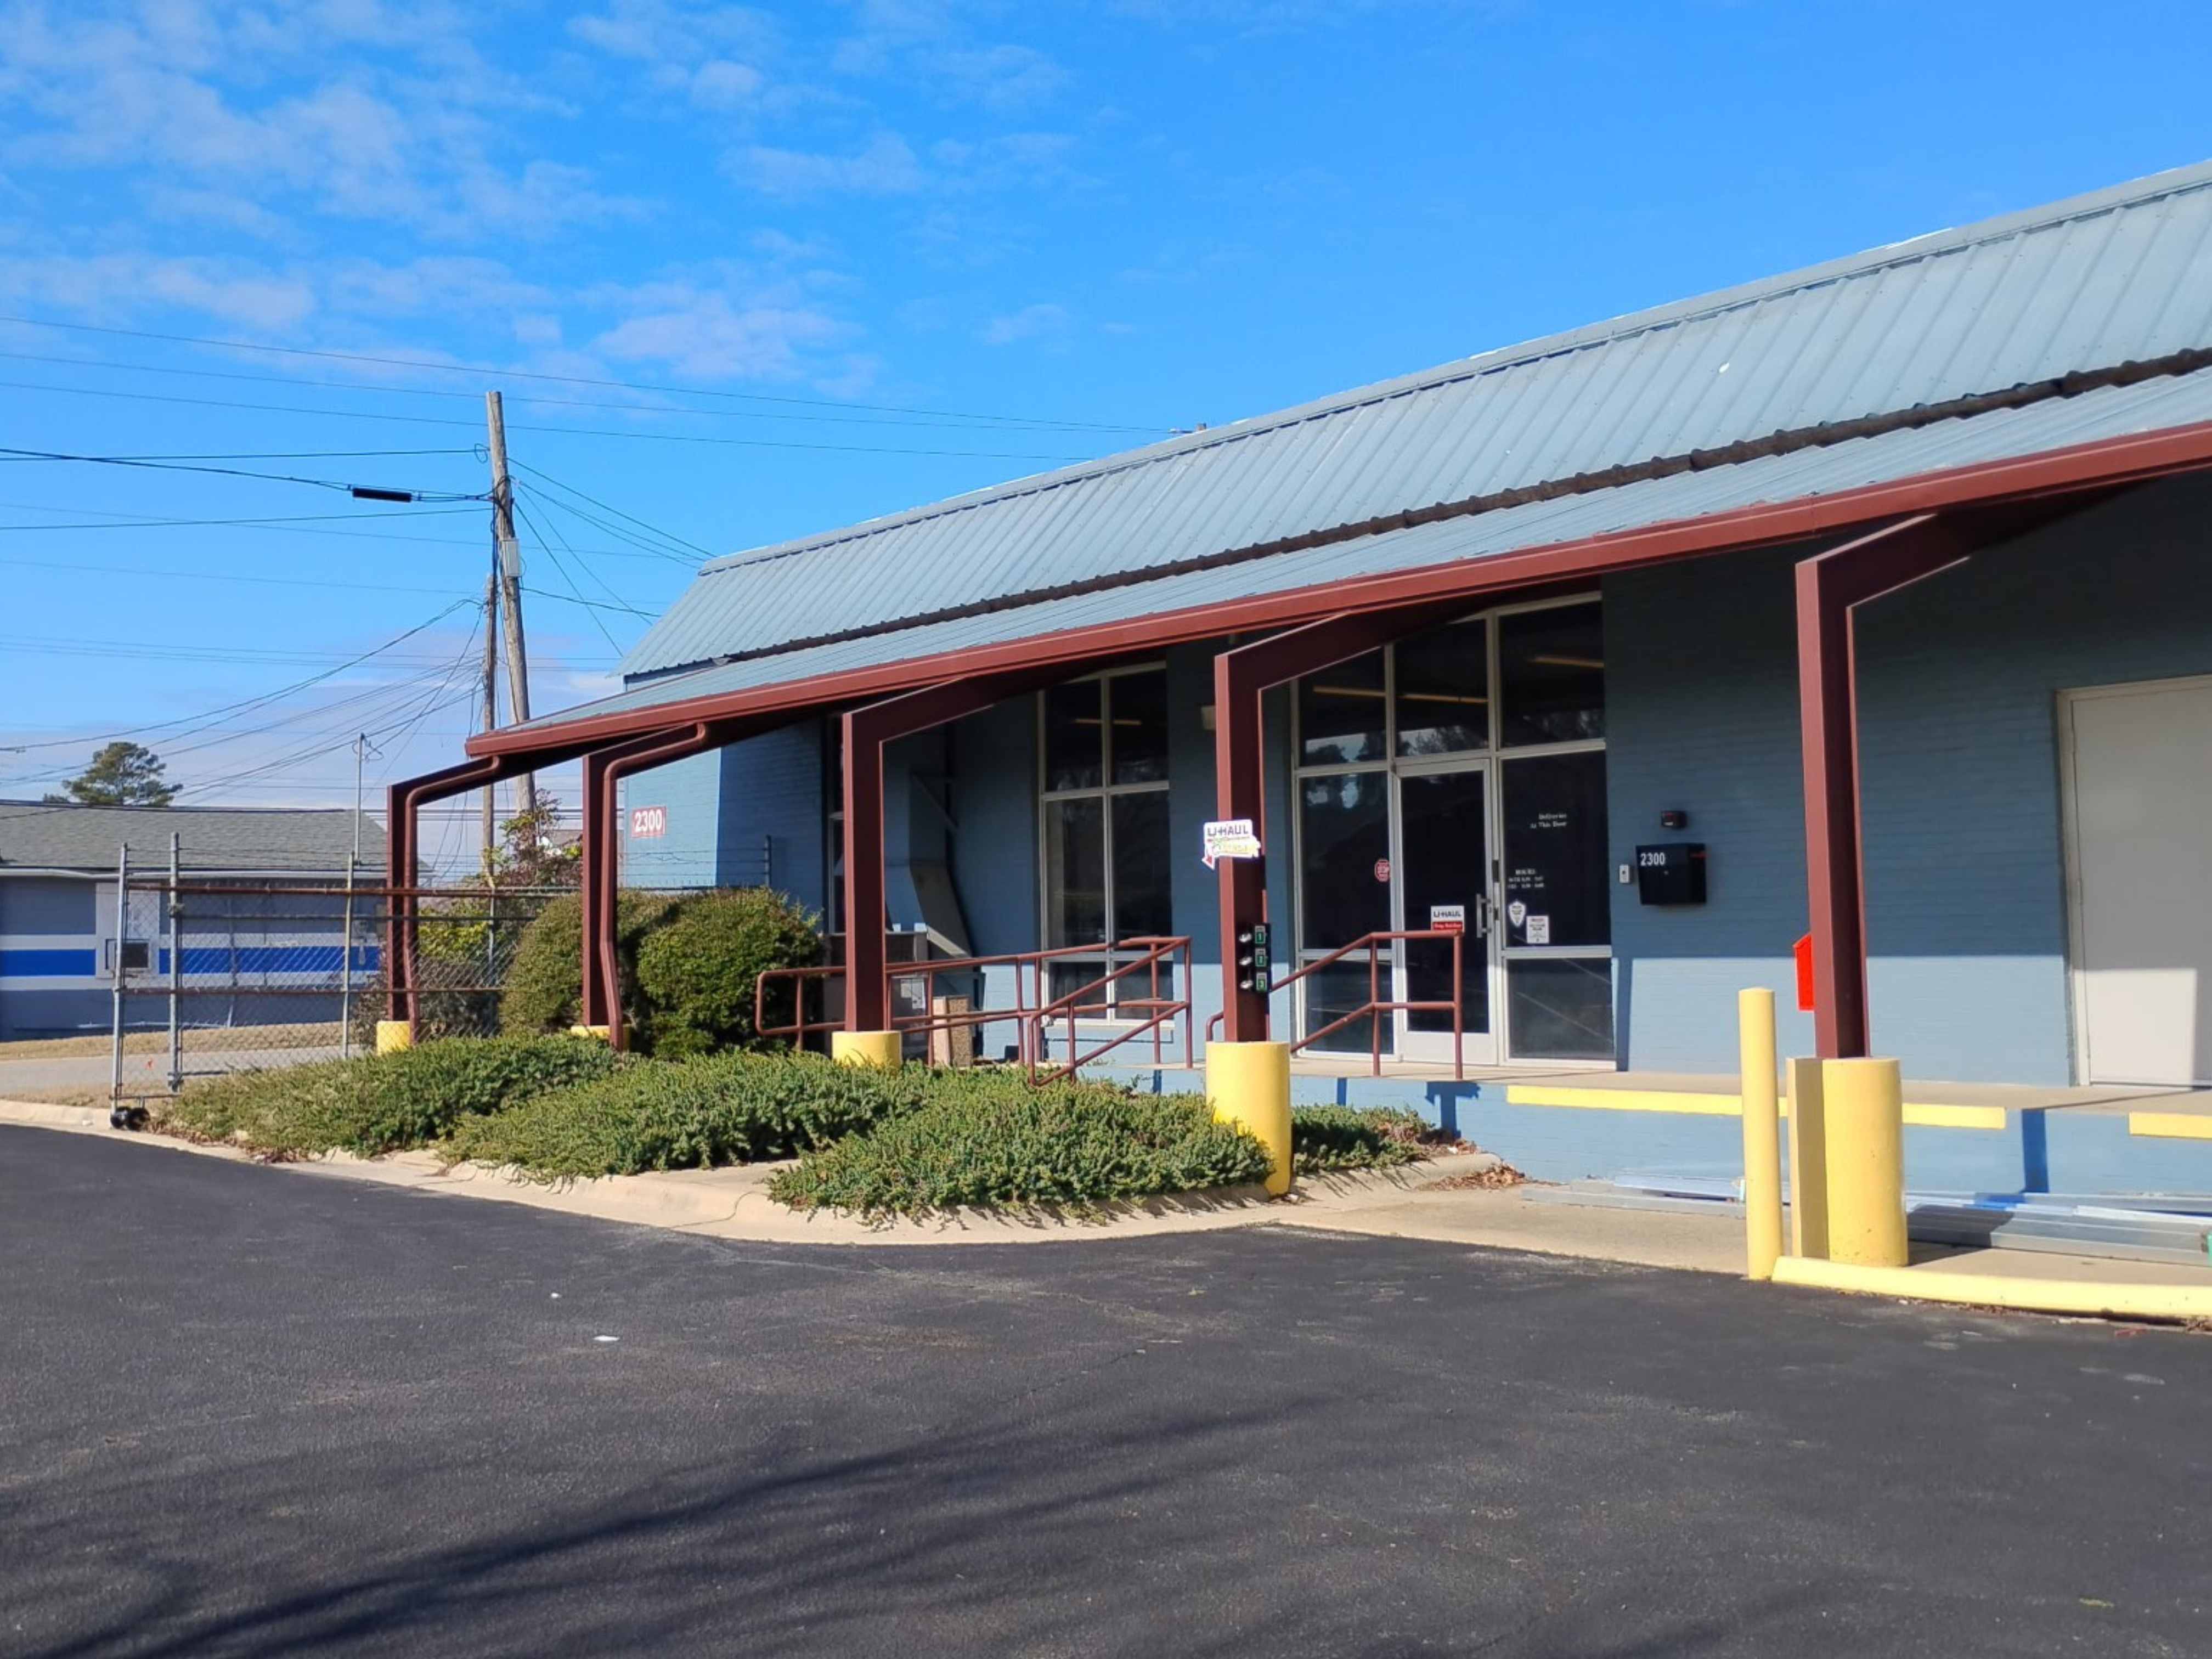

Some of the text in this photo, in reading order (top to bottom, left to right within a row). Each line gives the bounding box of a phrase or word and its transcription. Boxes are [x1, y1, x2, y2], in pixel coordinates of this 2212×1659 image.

[634, 809, 663, 832] 2300
[1206, 825, 1249, 836] U-HAUL
[1640, 852, 1666, 866] 2300
